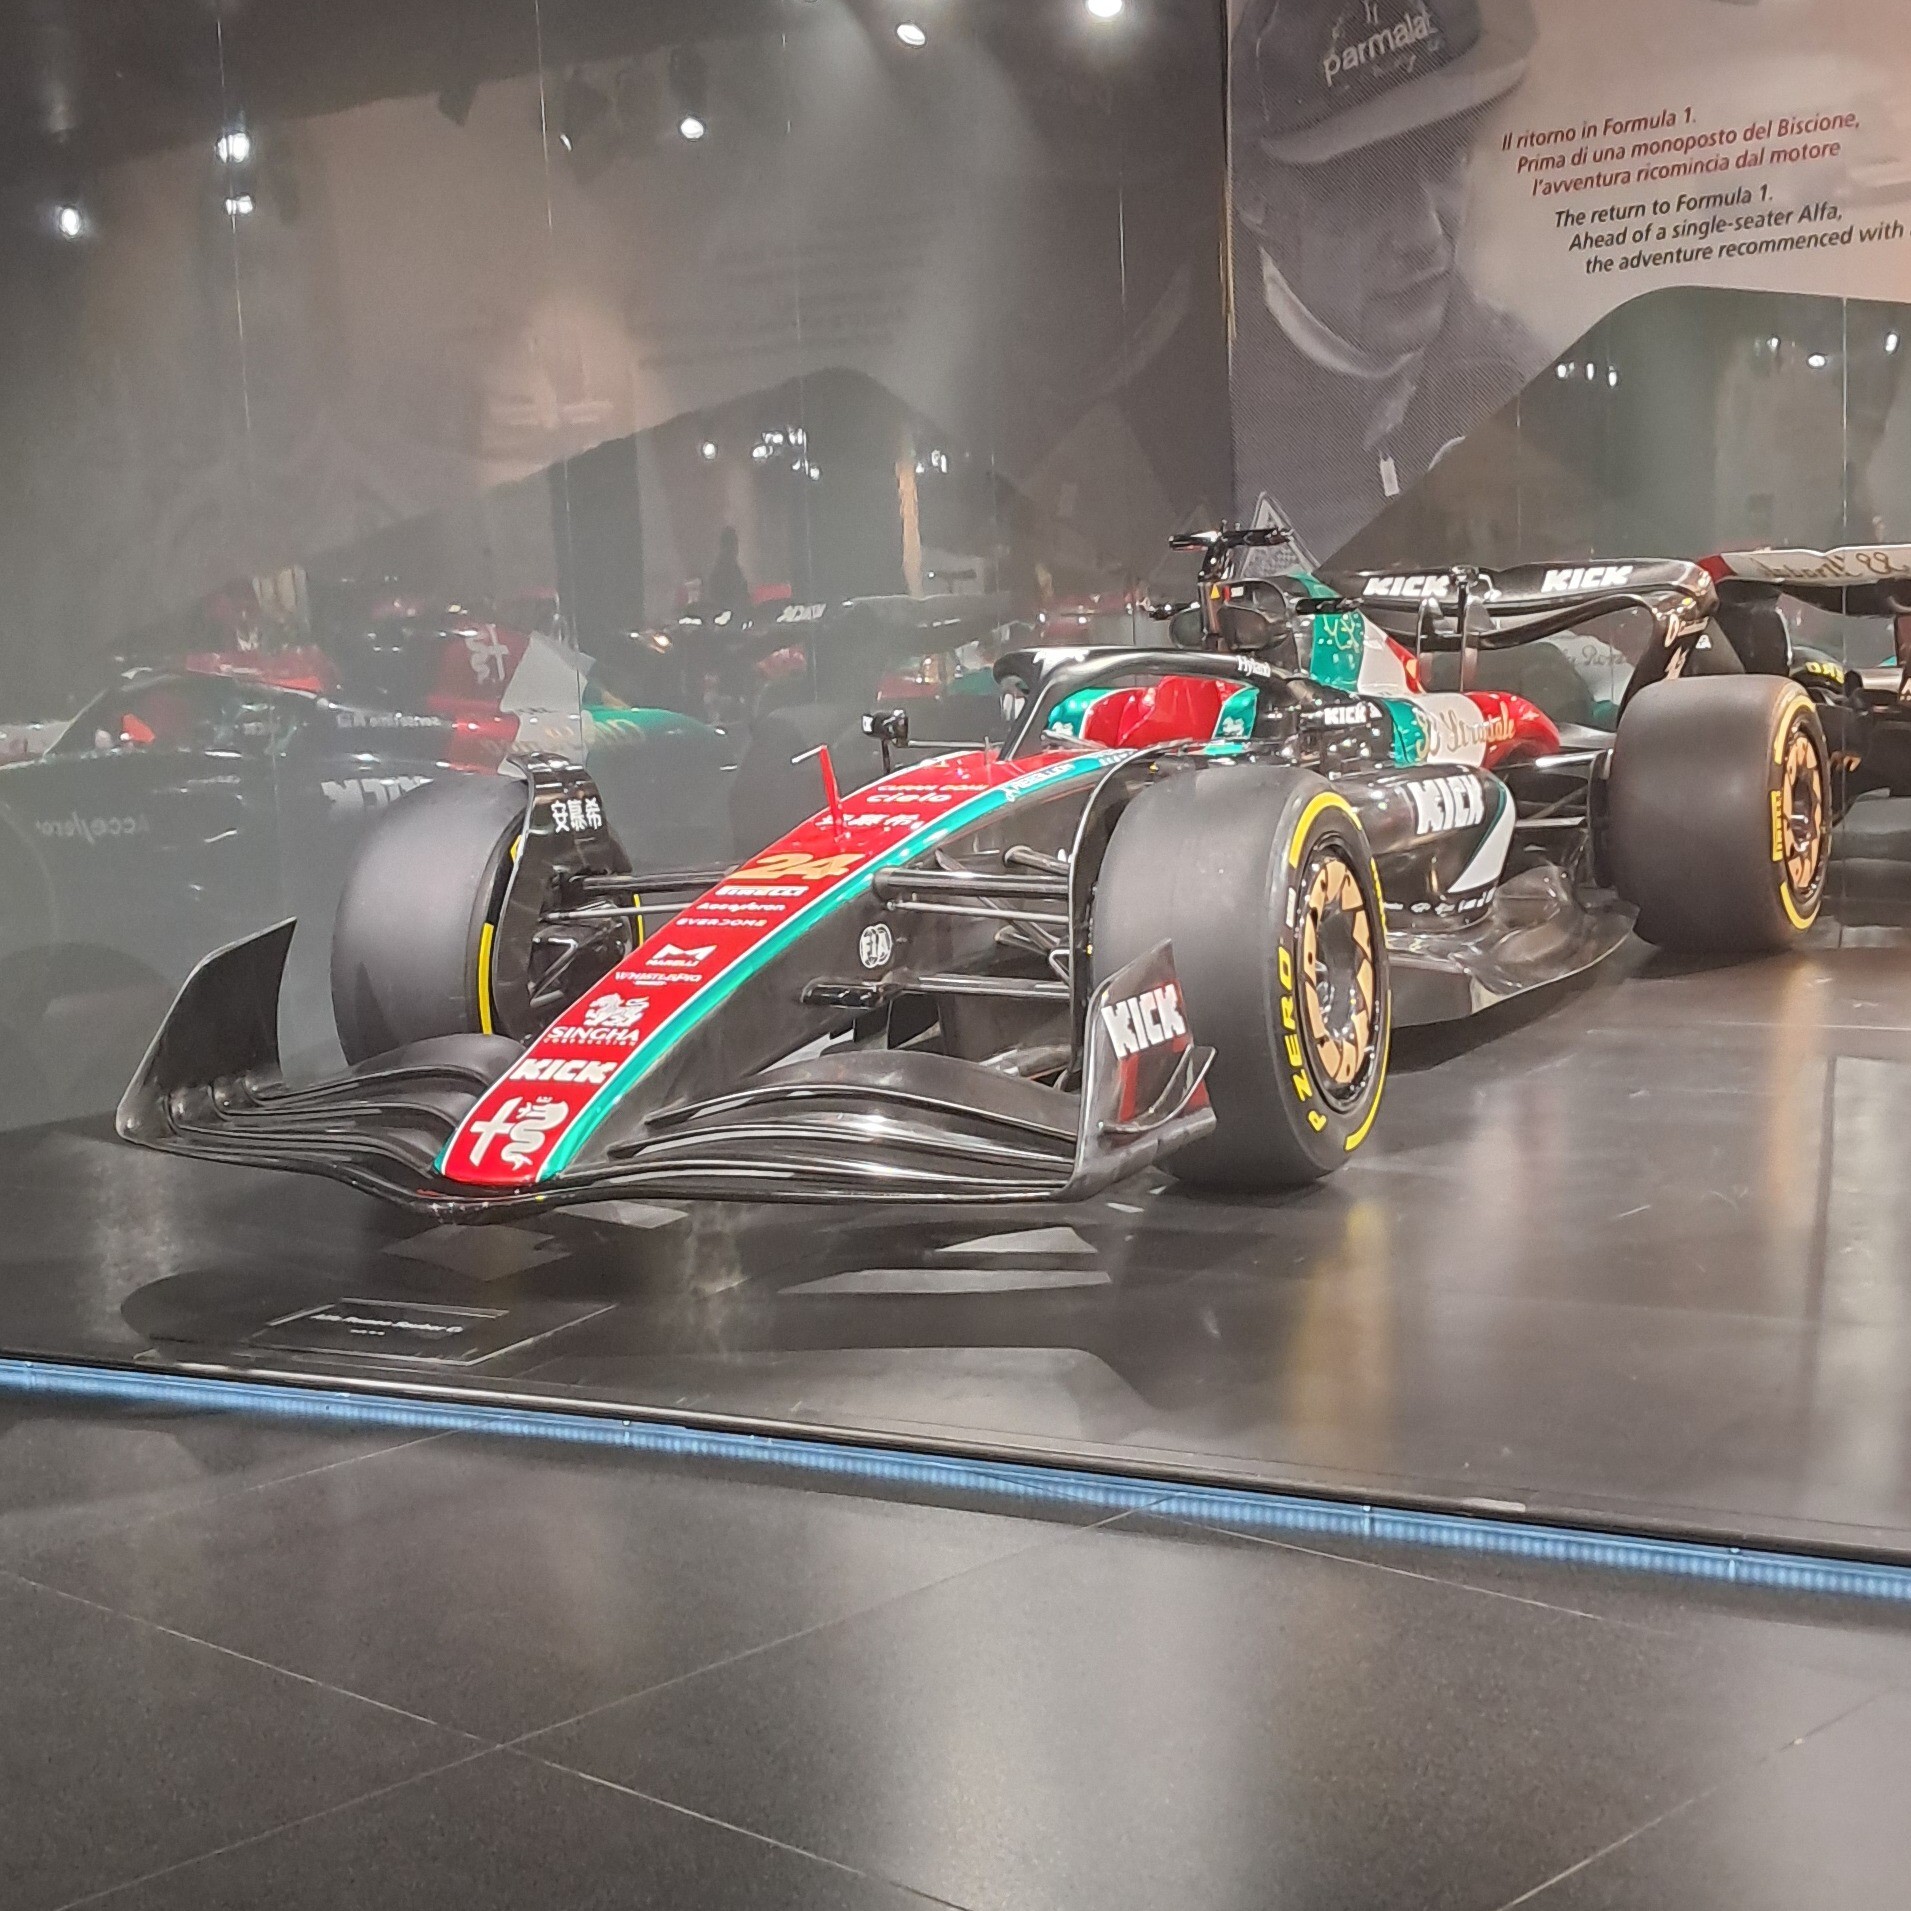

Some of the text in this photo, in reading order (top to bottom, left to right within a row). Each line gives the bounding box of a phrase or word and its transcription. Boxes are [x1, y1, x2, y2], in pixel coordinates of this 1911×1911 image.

[1323, 5, 1439, 87] parmalat
[1502, 106, 1696, 151] Il ritorno in Formula 1.
[1517, 112, 1860, 174] Prima di una monoposto del Biscione,
[1532, 141, 1841, 196] l'avventura ricomincia dal motore
[1555, 183, 1773, 228] The return to Formula 1.
[1569, 201, 1842, 252] Ahead of a single-seater Alfa,
[1586, 219, 1904, 275] the adventure recommenced with
[1363, 576, 1452, 597] KICK
[1540, 565, 1633, 593] KICK
[1324, 706, 1367, 726] KICK
[1413, 774, 1484, 835] KICK
[725, 853, 866, 880] 24
[549, 1026, 640, 1041] SINGHA
[1101, 983, 1186, 1060] KICK
[1278, 946, 1327, 1132] P ZERO
[509, 1058, 619, 1084] KICK
